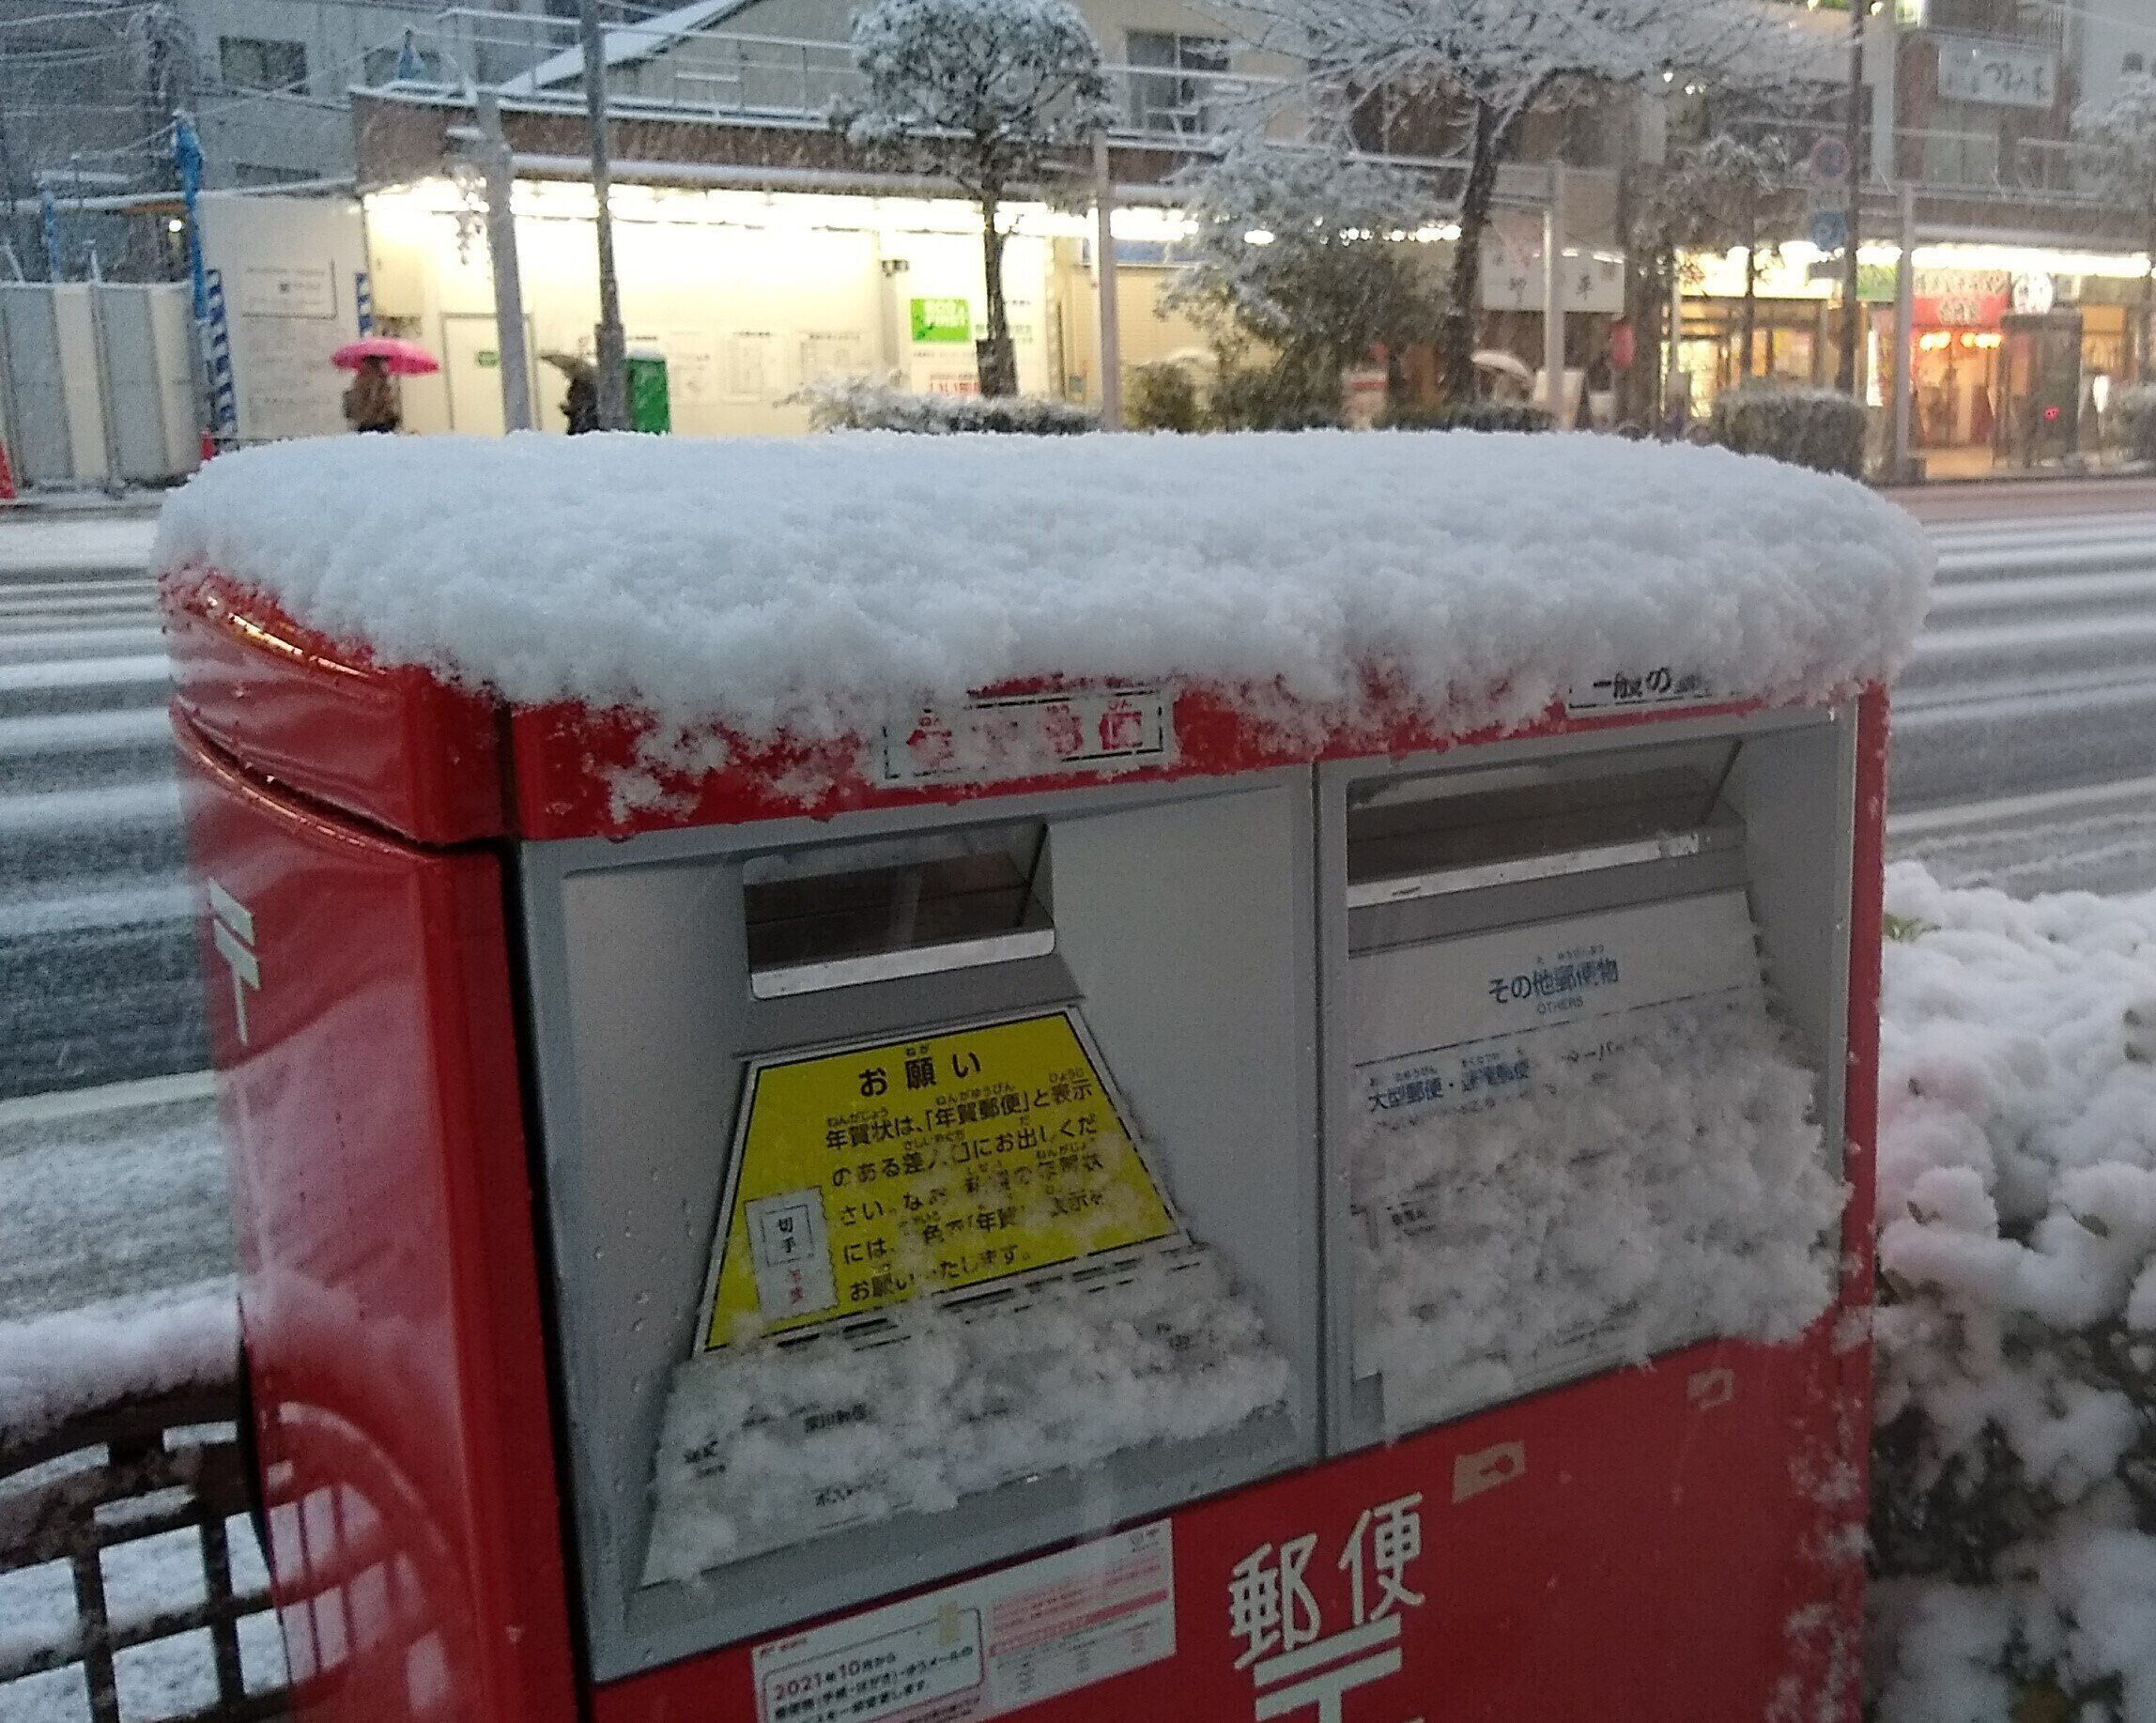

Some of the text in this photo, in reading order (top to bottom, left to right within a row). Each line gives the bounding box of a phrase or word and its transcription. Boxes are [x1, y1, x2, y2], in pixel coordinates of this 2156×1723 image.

[858, 1051, 981, 1098] お願い
[1228, 1490, 1426, 1670] 郵便
